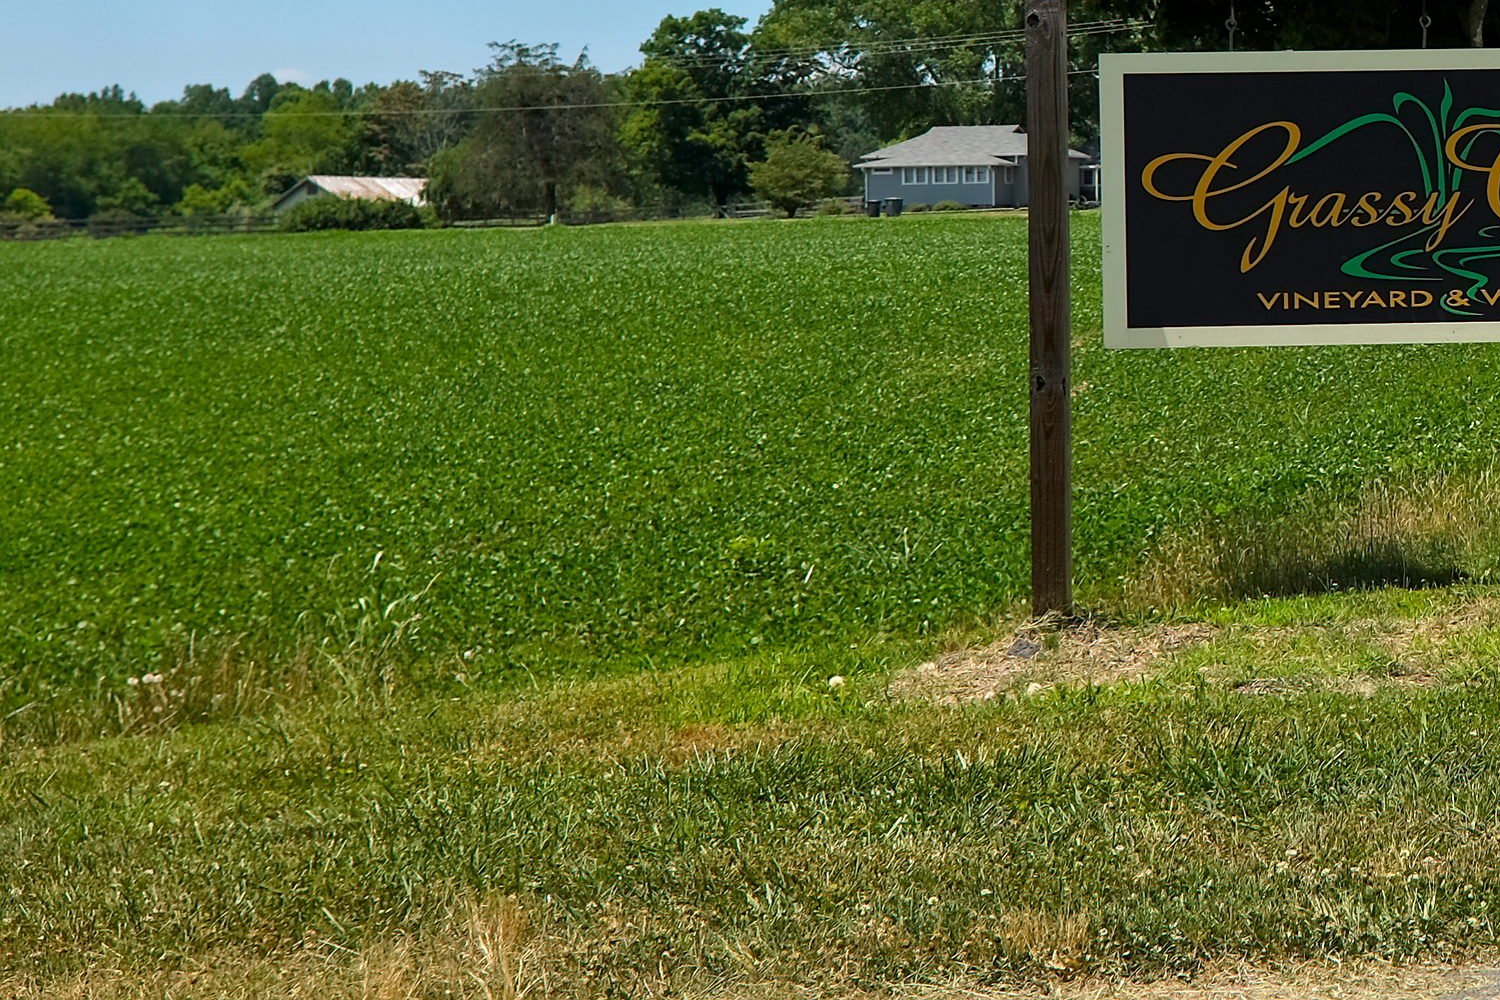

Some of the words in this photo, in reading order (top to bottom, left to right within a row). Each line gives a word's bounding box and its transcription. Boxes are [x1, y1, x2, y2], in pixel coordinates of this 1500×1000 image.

[1141, 121, 1474, 273] Grassy
[1257, 290, 1433, 310] VINEYARD
[1446, 290, 1470, 307] &
